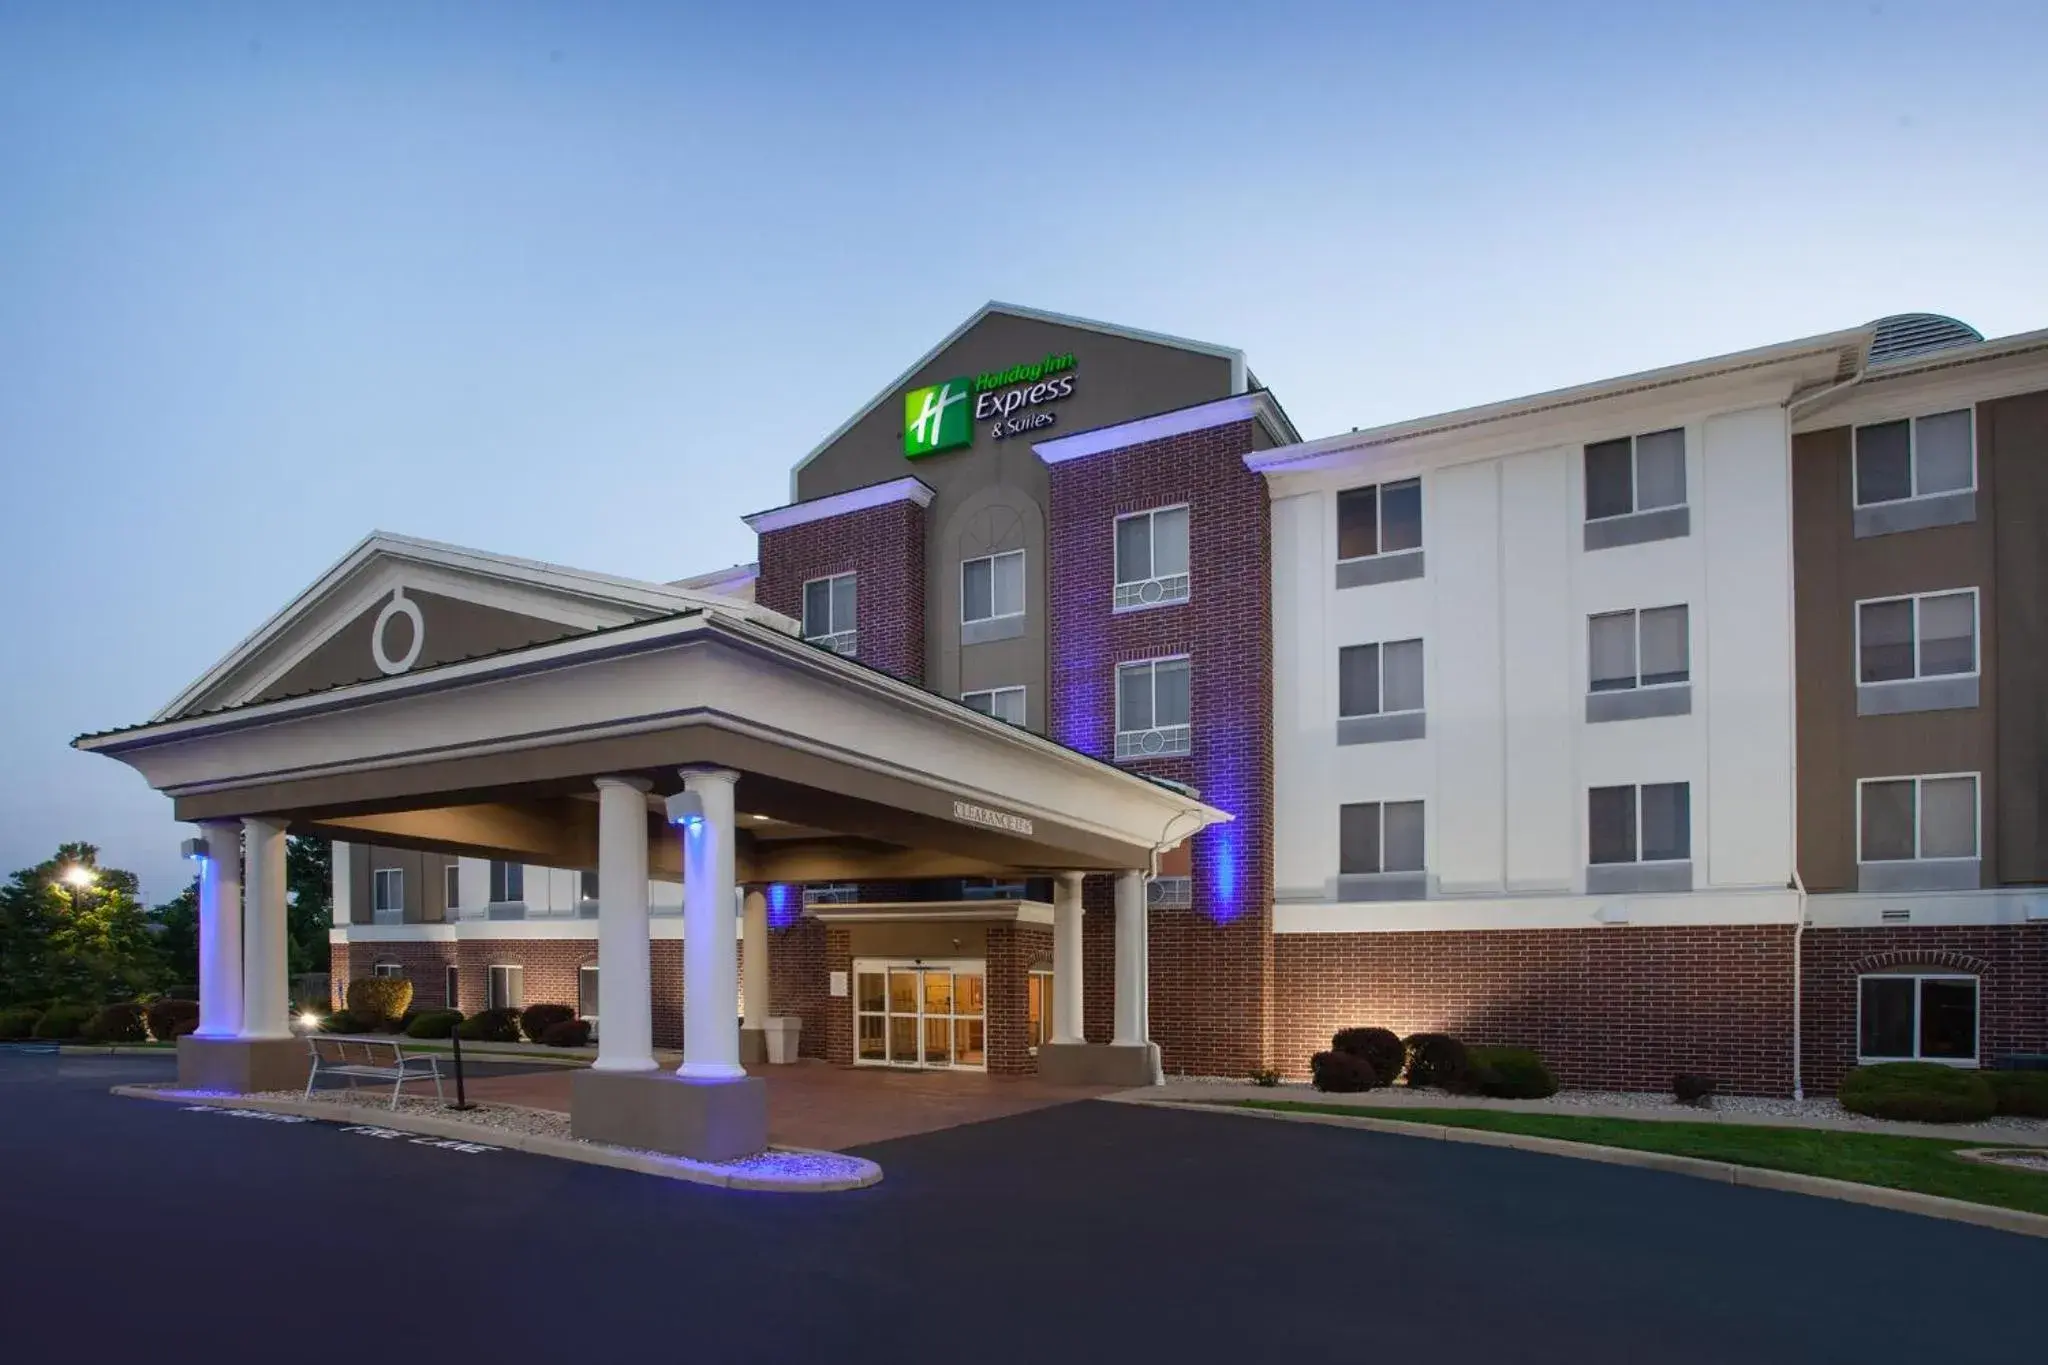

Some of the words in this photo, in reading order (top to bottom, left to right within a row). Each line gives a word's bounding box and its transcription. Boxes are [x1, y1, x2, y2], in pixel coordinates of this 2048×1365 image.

[976, 363, 1042, 392] Holiday
[1044, 352, 1074, 374] Inn
[975, 374, 1074, 420] Express
[991, 420, 1003, 440] &
[1006, 411, 1054, 434] Suites
